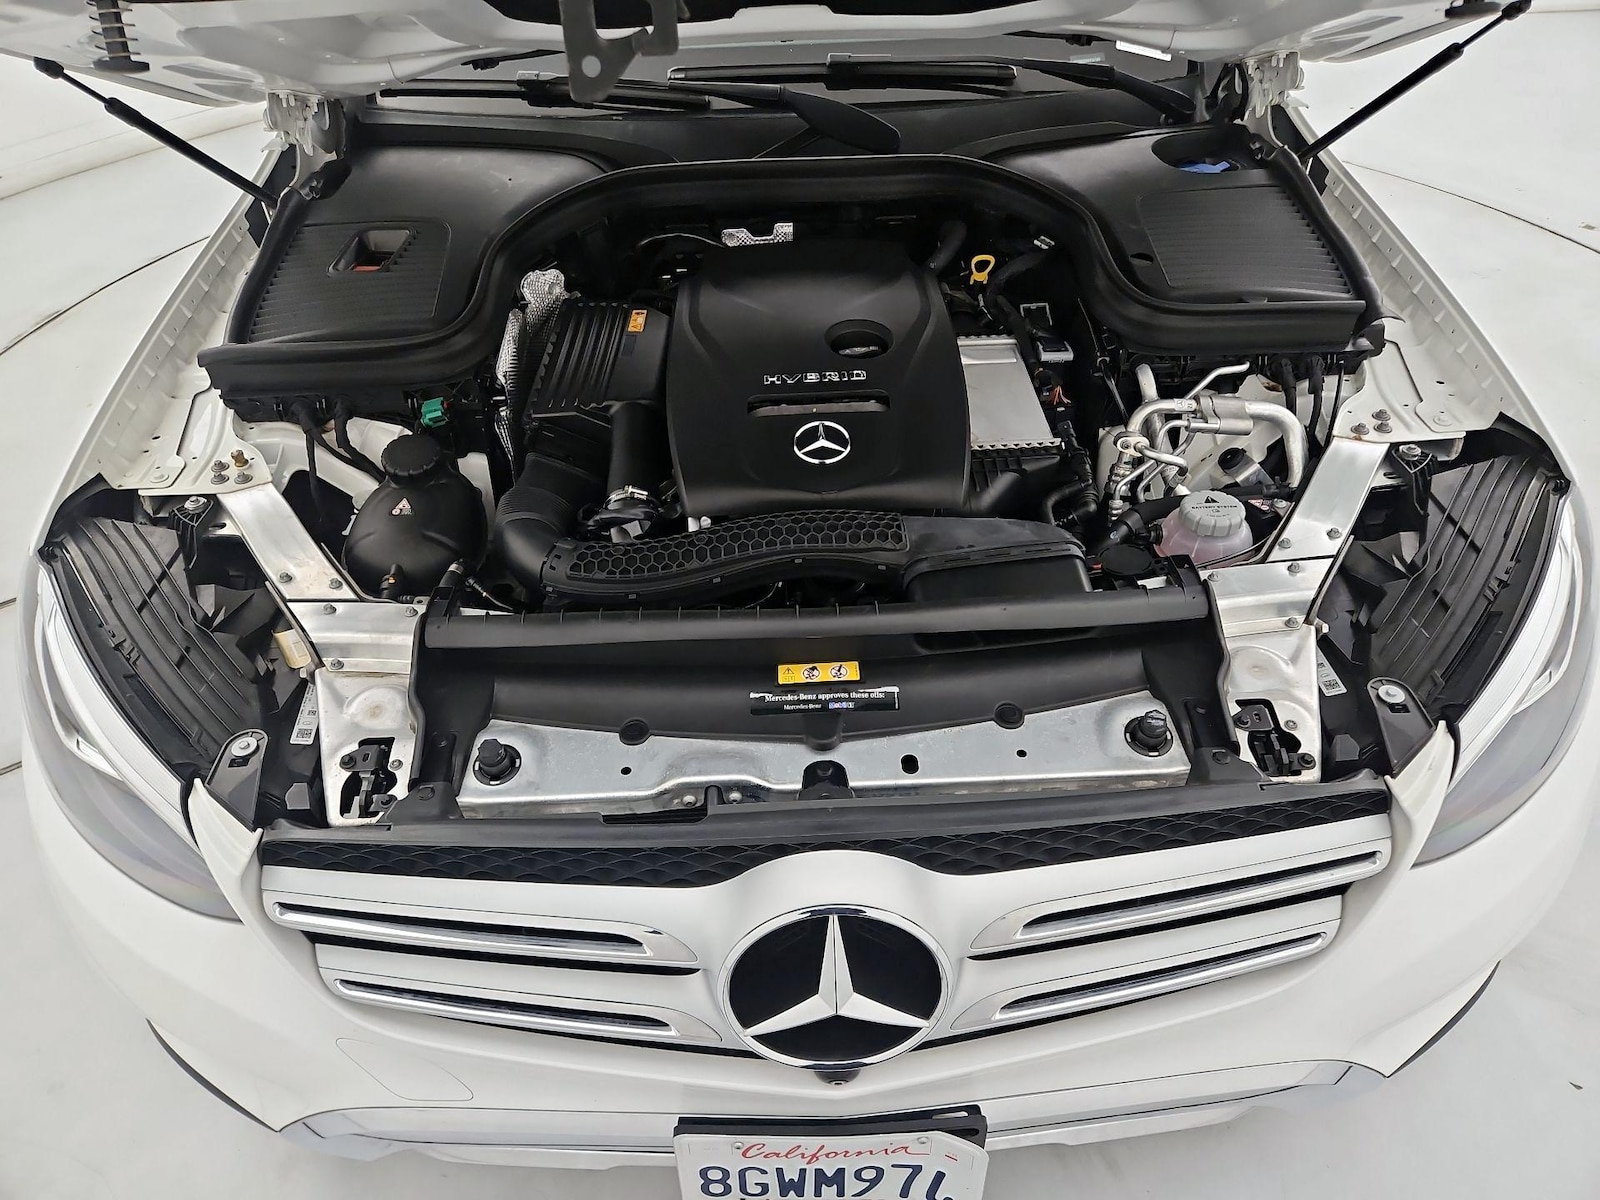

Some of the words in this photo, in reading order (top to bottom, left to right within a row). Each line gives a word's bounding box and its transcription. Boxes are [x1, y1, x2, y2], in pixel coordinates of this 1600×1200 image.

[763, 370, 867, 385] HYBRID
[764, 693, 817, 702] Mercedes-Benz
[818, 693, 849, 701] approves
[850, 691, 869, 699] these
[741, 1143, 930, 1165] California
